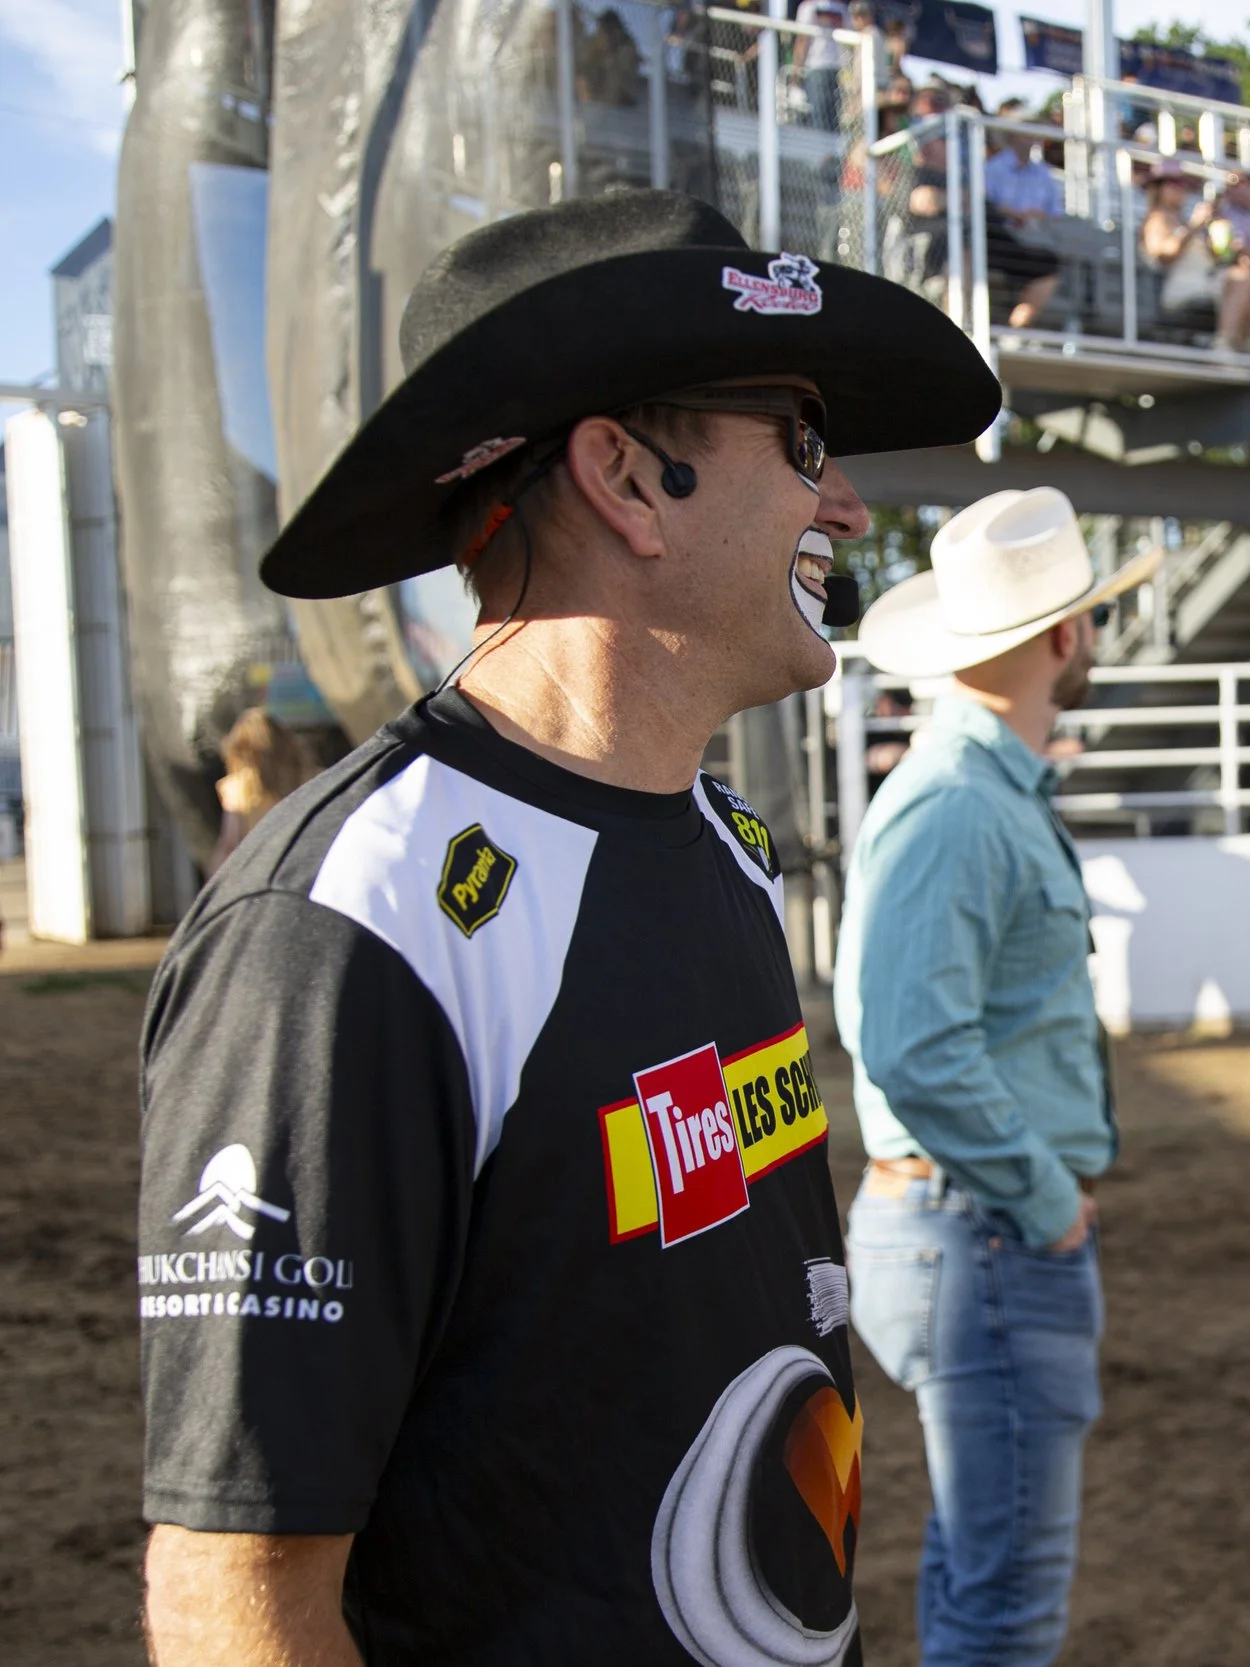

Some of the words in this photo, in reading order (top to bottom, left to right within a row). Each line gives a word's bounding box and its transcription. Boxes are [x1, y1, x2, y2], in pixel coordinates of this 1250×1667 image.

[731, 811, 770, 860] 811
[645, 1090, 735, 1194] Tires
[732, 1075, 776, 1149] LES
[775, 1050, 821, 1126] SCH
[226, 1291, 344, 1323] CASINO
